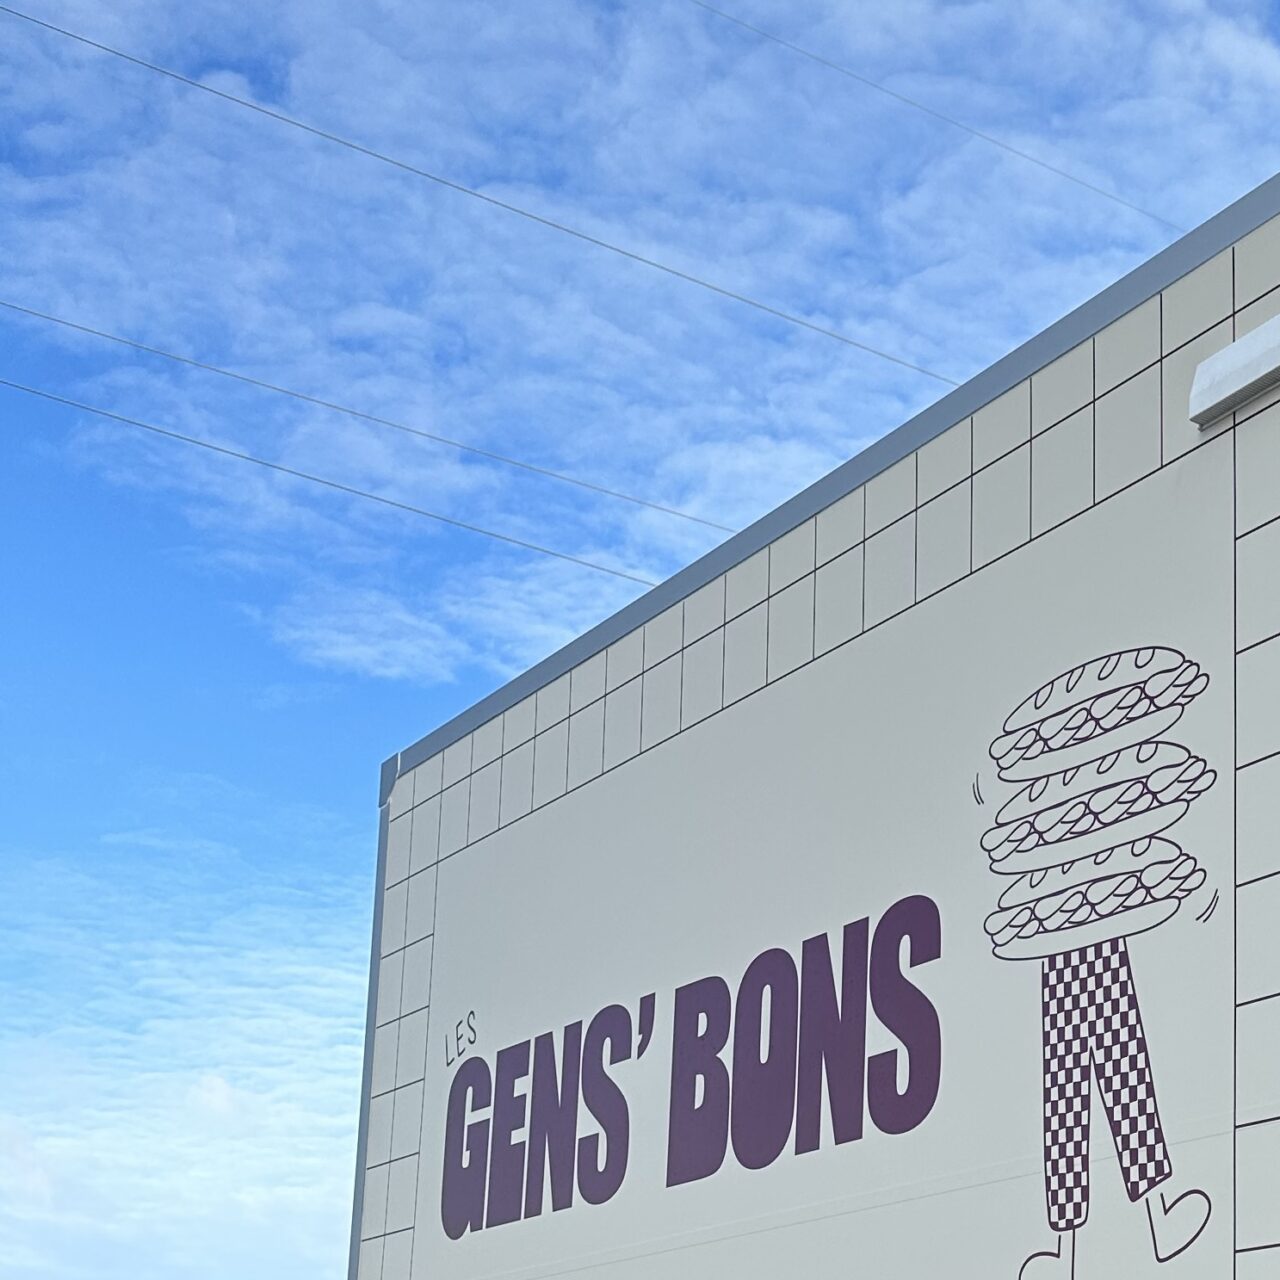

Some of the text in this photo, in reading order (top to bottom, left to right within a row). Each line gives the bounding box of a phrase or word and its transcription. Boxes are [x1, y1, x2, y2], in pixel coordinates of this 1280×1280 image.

[440, 894, 942, 1241] GENS' BONS
[444, 1010, 476, 1067] LES
